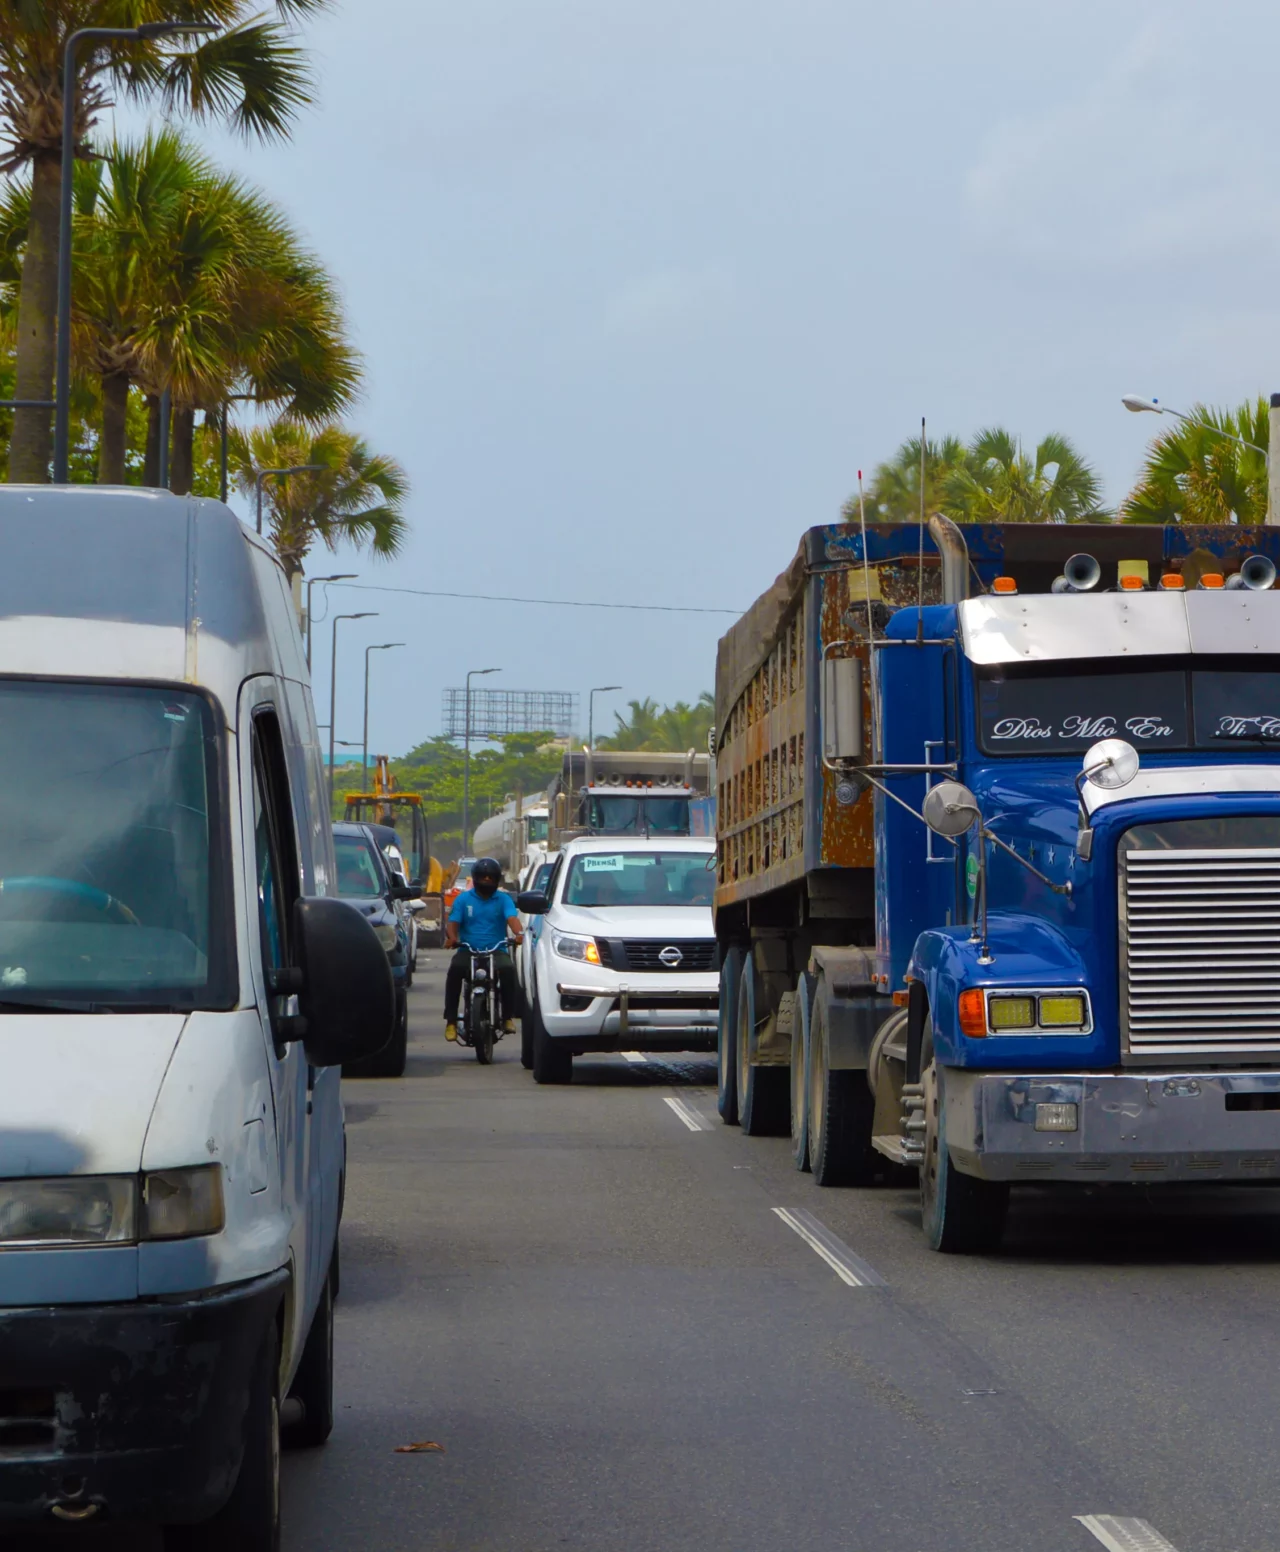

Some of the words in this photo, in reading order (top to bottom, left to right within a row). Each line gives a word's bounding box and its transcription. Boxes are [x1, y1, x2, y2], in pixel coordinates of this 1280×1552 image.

[991, 717, 1052, 739] Dios
[1058, 715, 1118, 738] Mio
[1125, 716, 1174, 739] En
[1215, 715, 1261, 736] Ti
